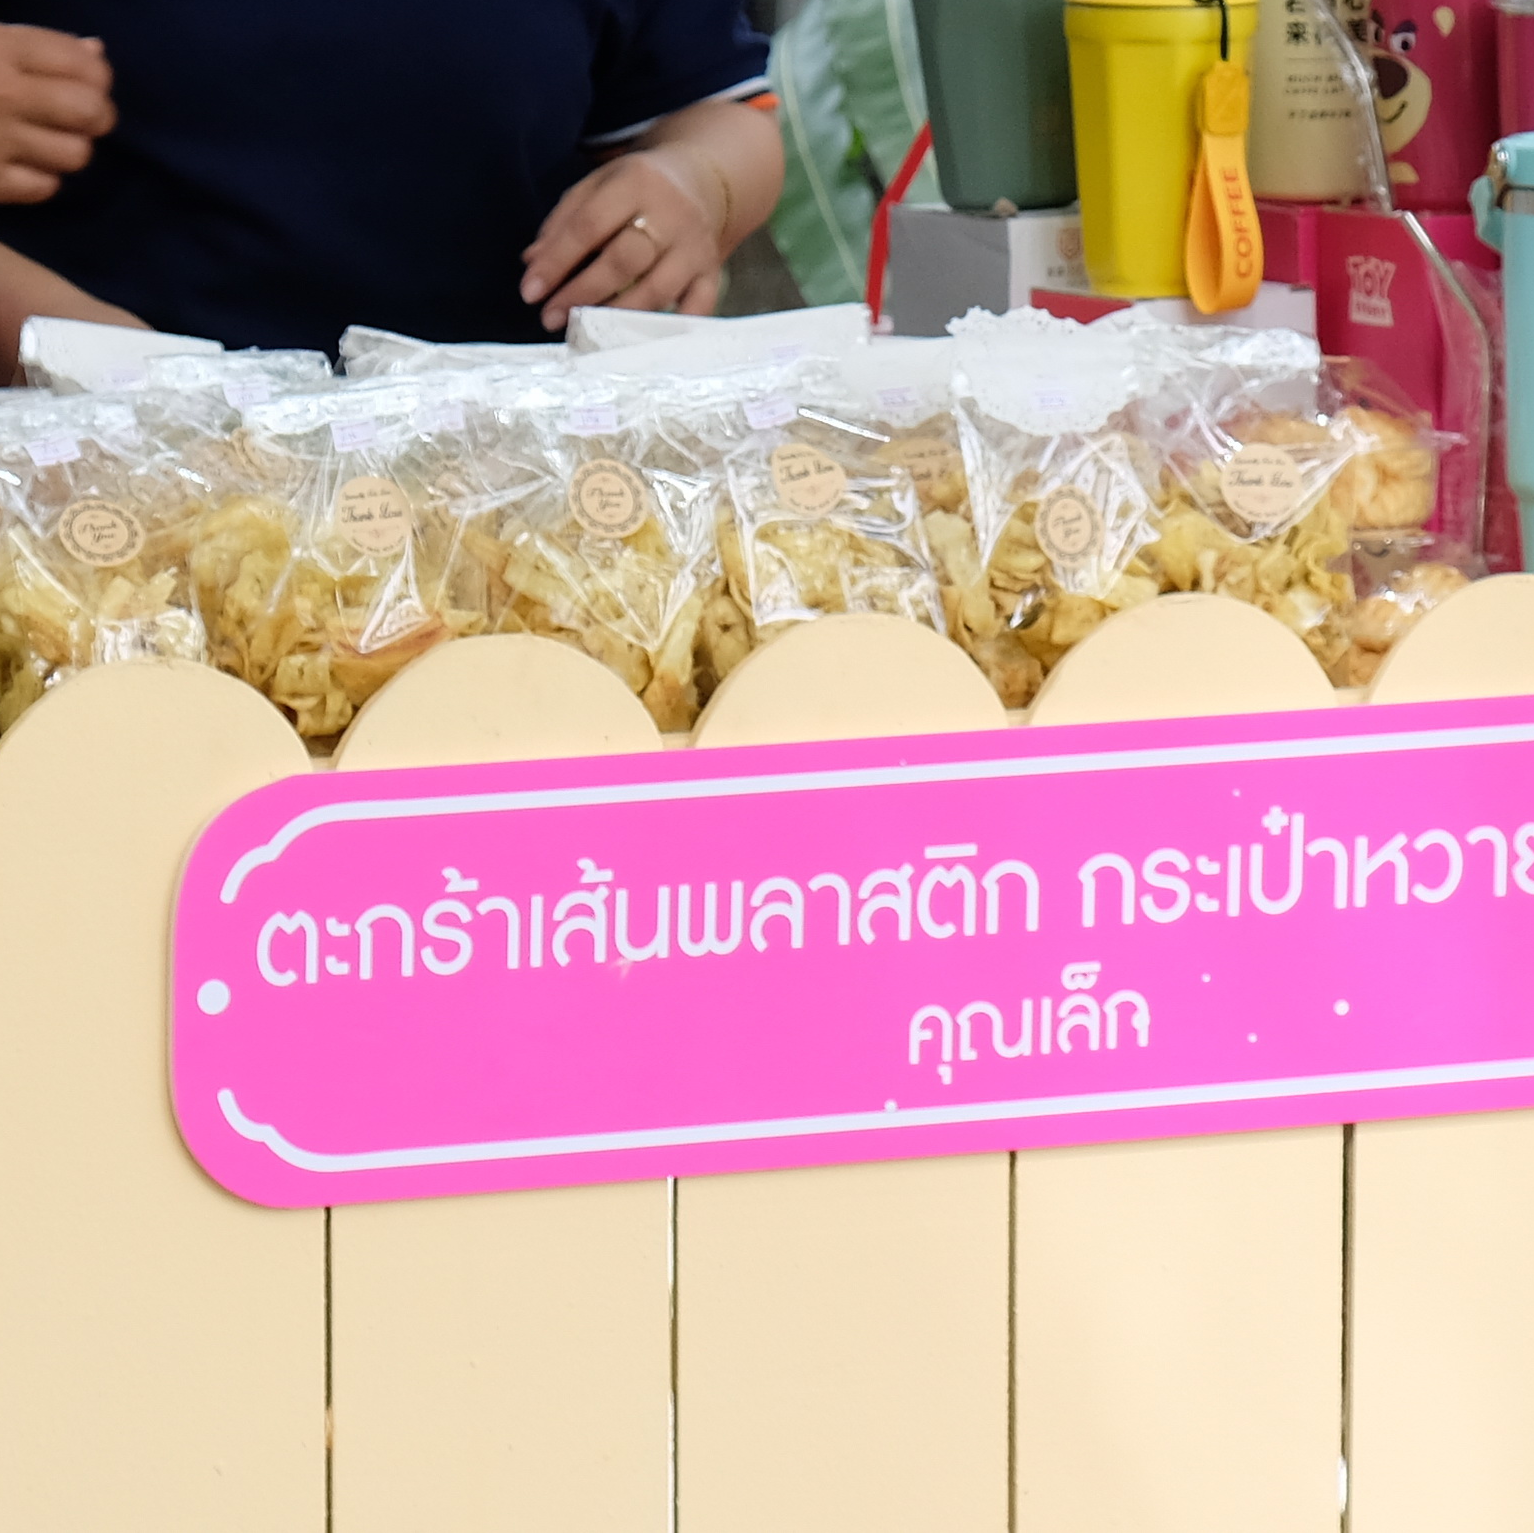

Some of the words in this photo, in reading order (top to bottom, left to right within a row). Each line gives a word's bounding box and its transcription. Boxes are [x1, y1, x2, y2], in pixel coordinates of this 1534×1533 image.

[1222, 168, 1253, 279] COFFEE
[1345, 255, 1398, 300] TOY
[256, 843, 1040, 987] ตะกร้าเส้นพลาสติก
[908, 961, 1151, 1085] คุณเล็ก
